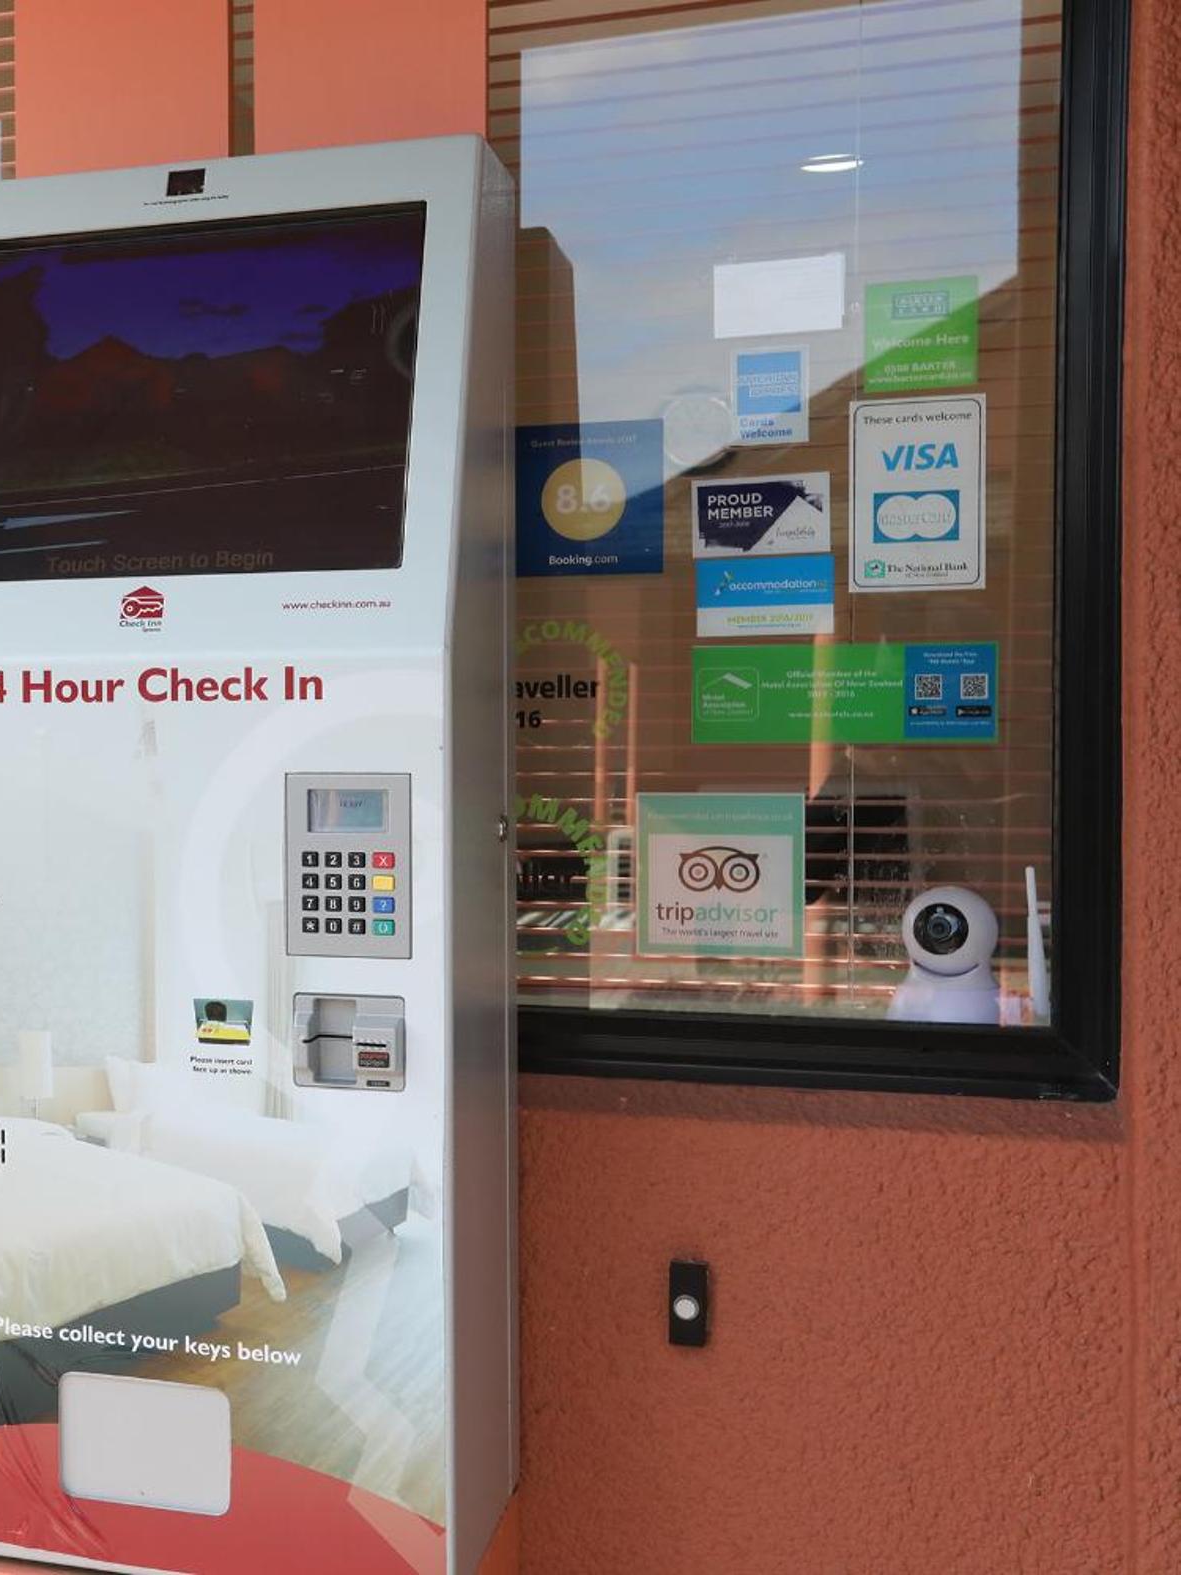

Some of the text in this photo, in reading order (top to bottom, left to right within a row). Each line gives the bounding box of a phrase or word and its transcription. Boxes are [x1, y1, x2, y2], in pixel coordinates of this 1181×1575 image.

[874, 333, 969, 350] Welcome Here
[740, 417, 775, 427] Cards
[863, 411, 972, 425] These cards welcome
[740, 428, 793, 439] Welcome
[882, 442, 959, 471] VISA
[555, 484, 612, 514] 8.6
[707, 492, 763, 507] PROUD
[707, 505, 774, 521] MEMBER
[47, 550, 274, 574] Touch Screen to Begin
[548, 554, 619, 567] Booking.com
[887, 562, 968, 573] The National Bank
[729, 578, 817, 592] accommodation
[282, 599, 392, 610] www.checkinn.com.au
[119, 620, 146, 628] Check
[21, 669, 125, 704] Hour
[137, 666, 269, 703] Check
[283, 665, 324, 701] In
[307, 854, 313, 865] 1
[330, 854, 337, 866] 2
[353, 855, 360, 866] 3
[306, 877, 360, 888] 4 5 6
[306, 899, 313, 909] 7
[330, 899, 337, 910] 8
[353, 900, 360, 911] 9
[655, 901, 779, 926] tripadvisor
[662, 927, 779, 939] The world's largest travel site
[190, 1056, 213, 1064] Please
[59, 1324, 126, 1347] collect
[131, 1333, 179, 1353] your
[185, 1335, 231, 1362] keys
[237, 1341, 302, 1366] below
